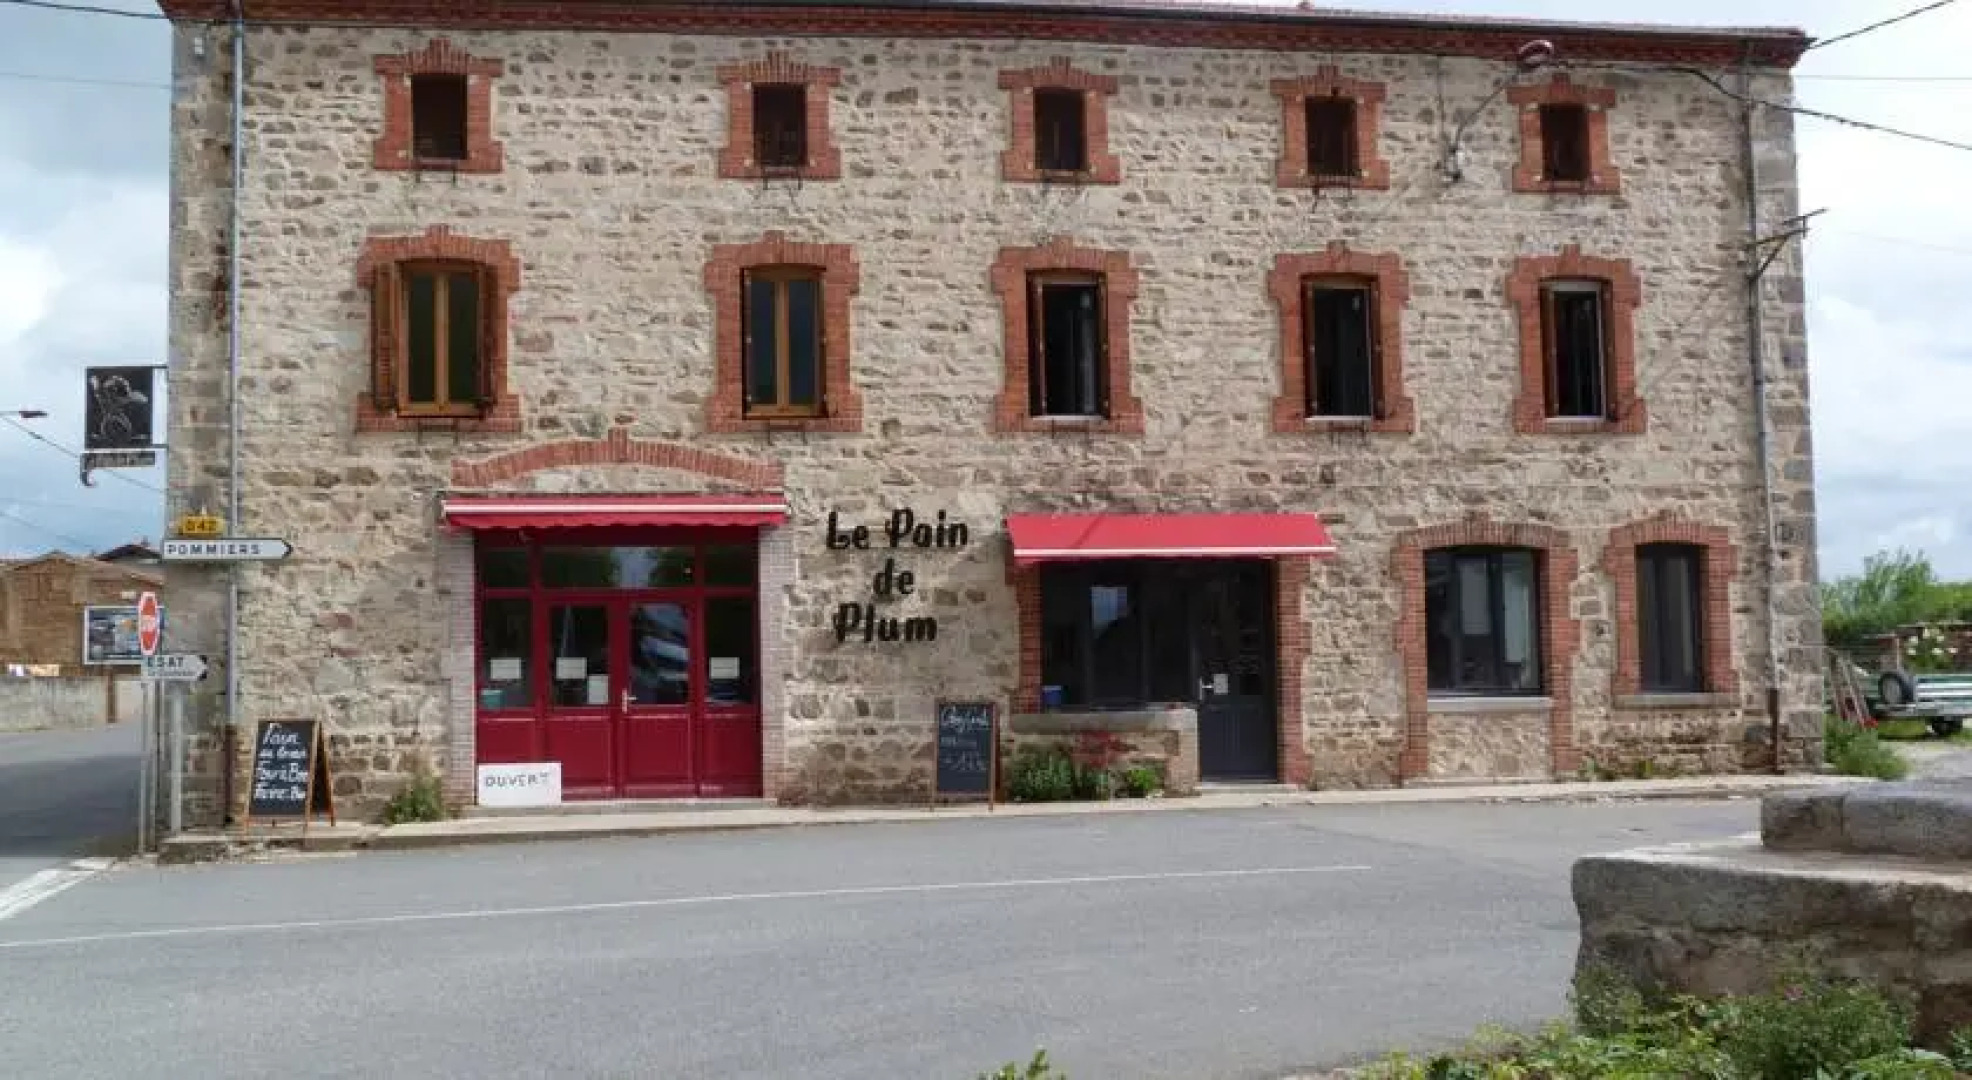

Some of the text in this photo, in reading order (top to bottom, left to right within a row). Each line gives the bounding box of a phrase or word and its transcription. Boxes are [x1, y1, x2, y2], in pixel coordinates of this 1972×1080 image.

[826, 508, 968, 549] Le Pain
[168, 544, 260, 555] POMMIERS
[873, 558, 914, 595] de
[833, 602, 938, 641] Plum
